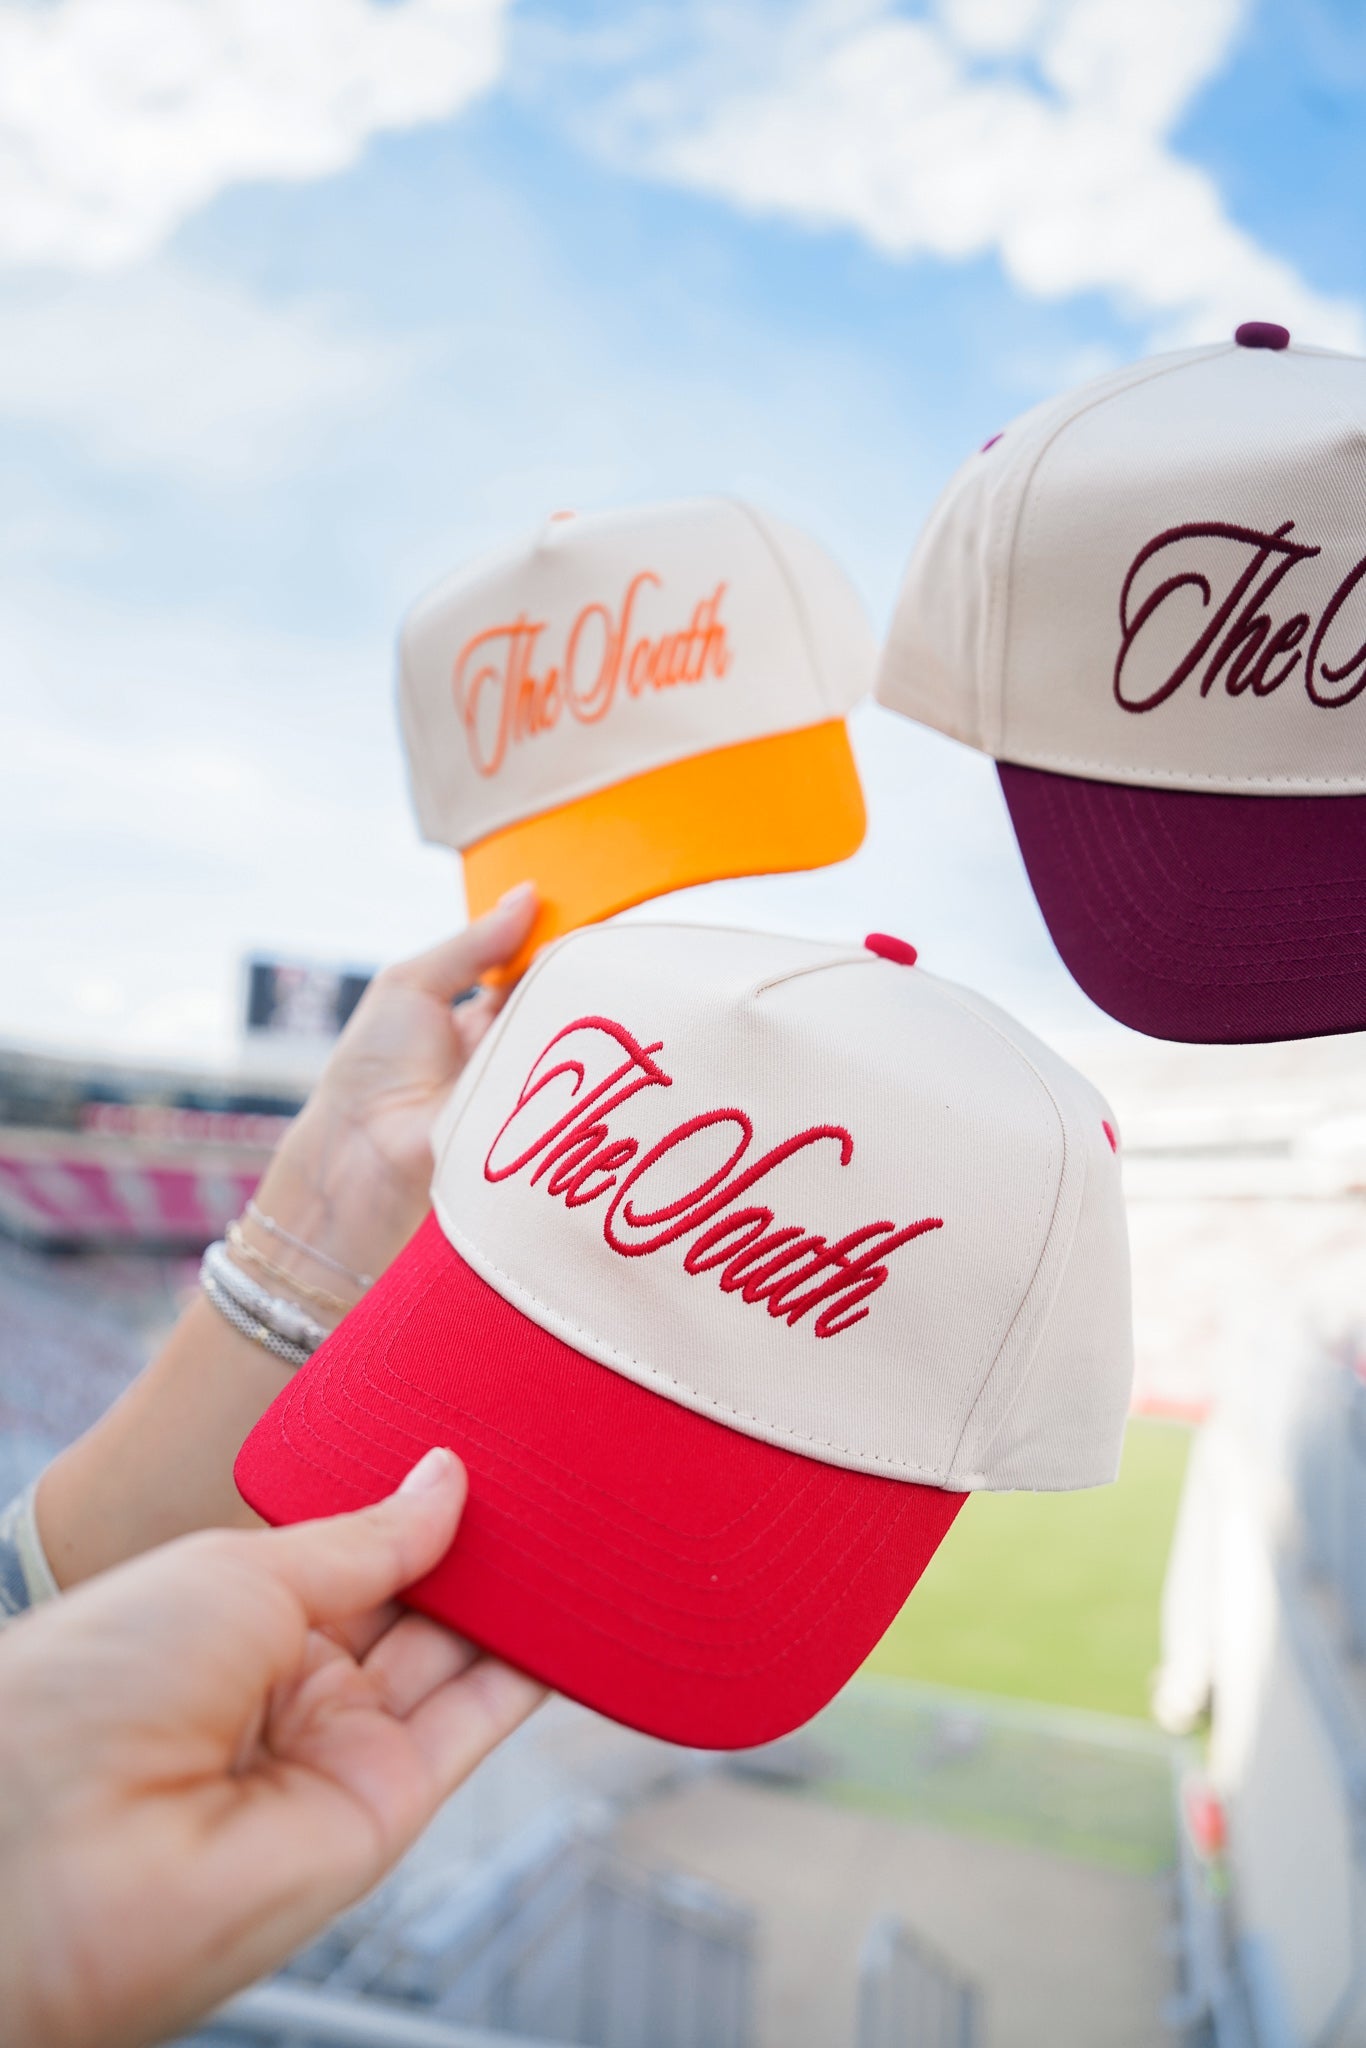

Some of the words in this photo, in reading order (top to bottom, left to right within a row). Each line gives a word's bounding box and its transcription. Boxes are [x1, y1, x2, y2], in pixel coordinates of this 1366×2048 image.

[452, 612, 562, 779] The
[565, 571, 732, 724] South
[1113, 520, 1321, 713] The
[484, 1016, 672, 1208] The
[604, 1108, 943, 1339] South
